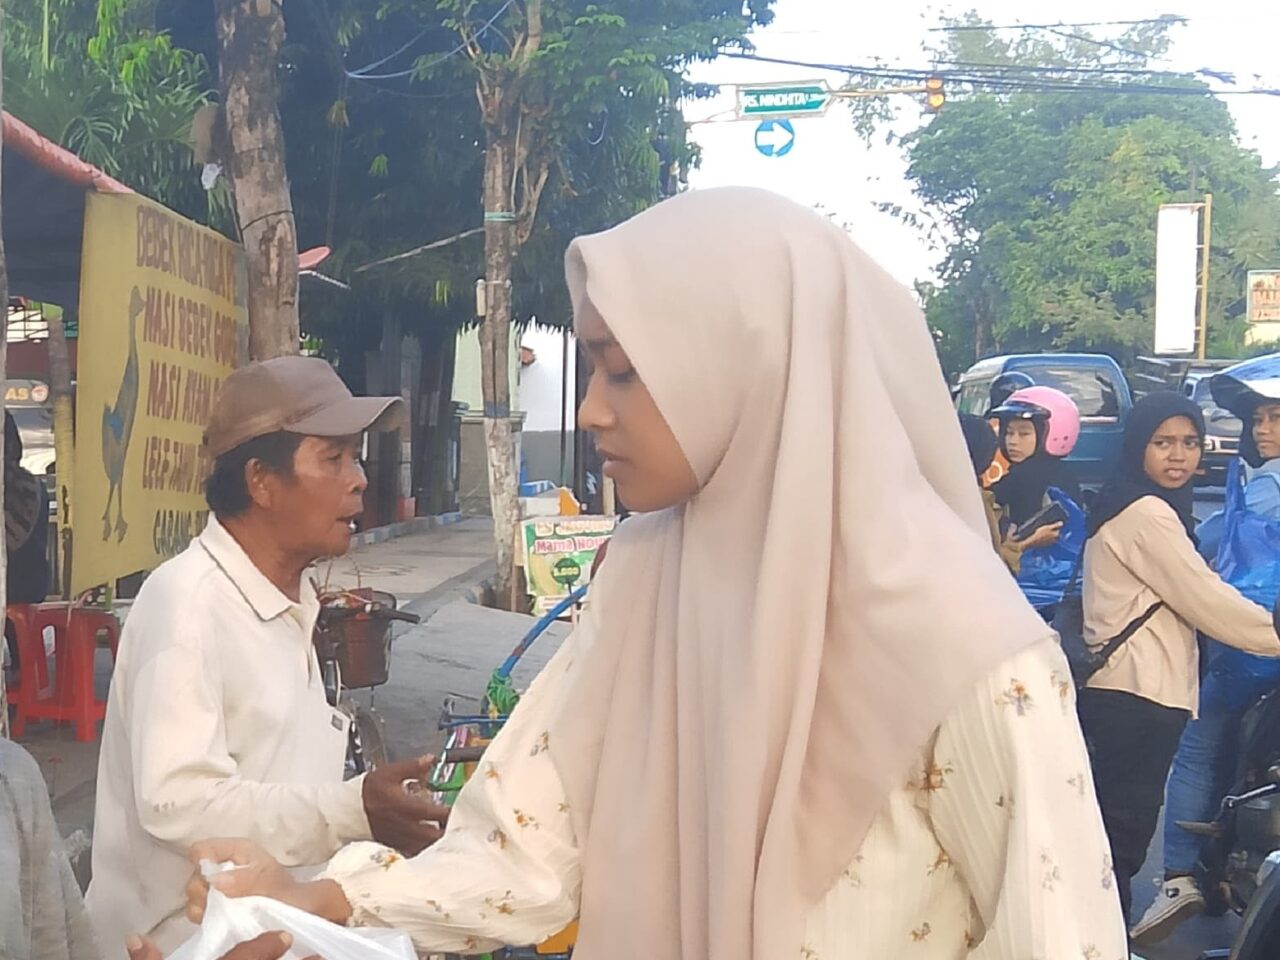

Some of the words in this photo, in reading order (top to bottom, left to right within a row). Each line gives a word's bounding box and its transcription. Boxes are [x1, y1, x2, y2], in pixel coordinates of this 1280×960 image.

[136, 204, 177, 278] BEBEK
[143, 284, 176, 350] NASI
[178, 296, 212, 358] BEBEK
[147, 359, 181, 422] NASI
